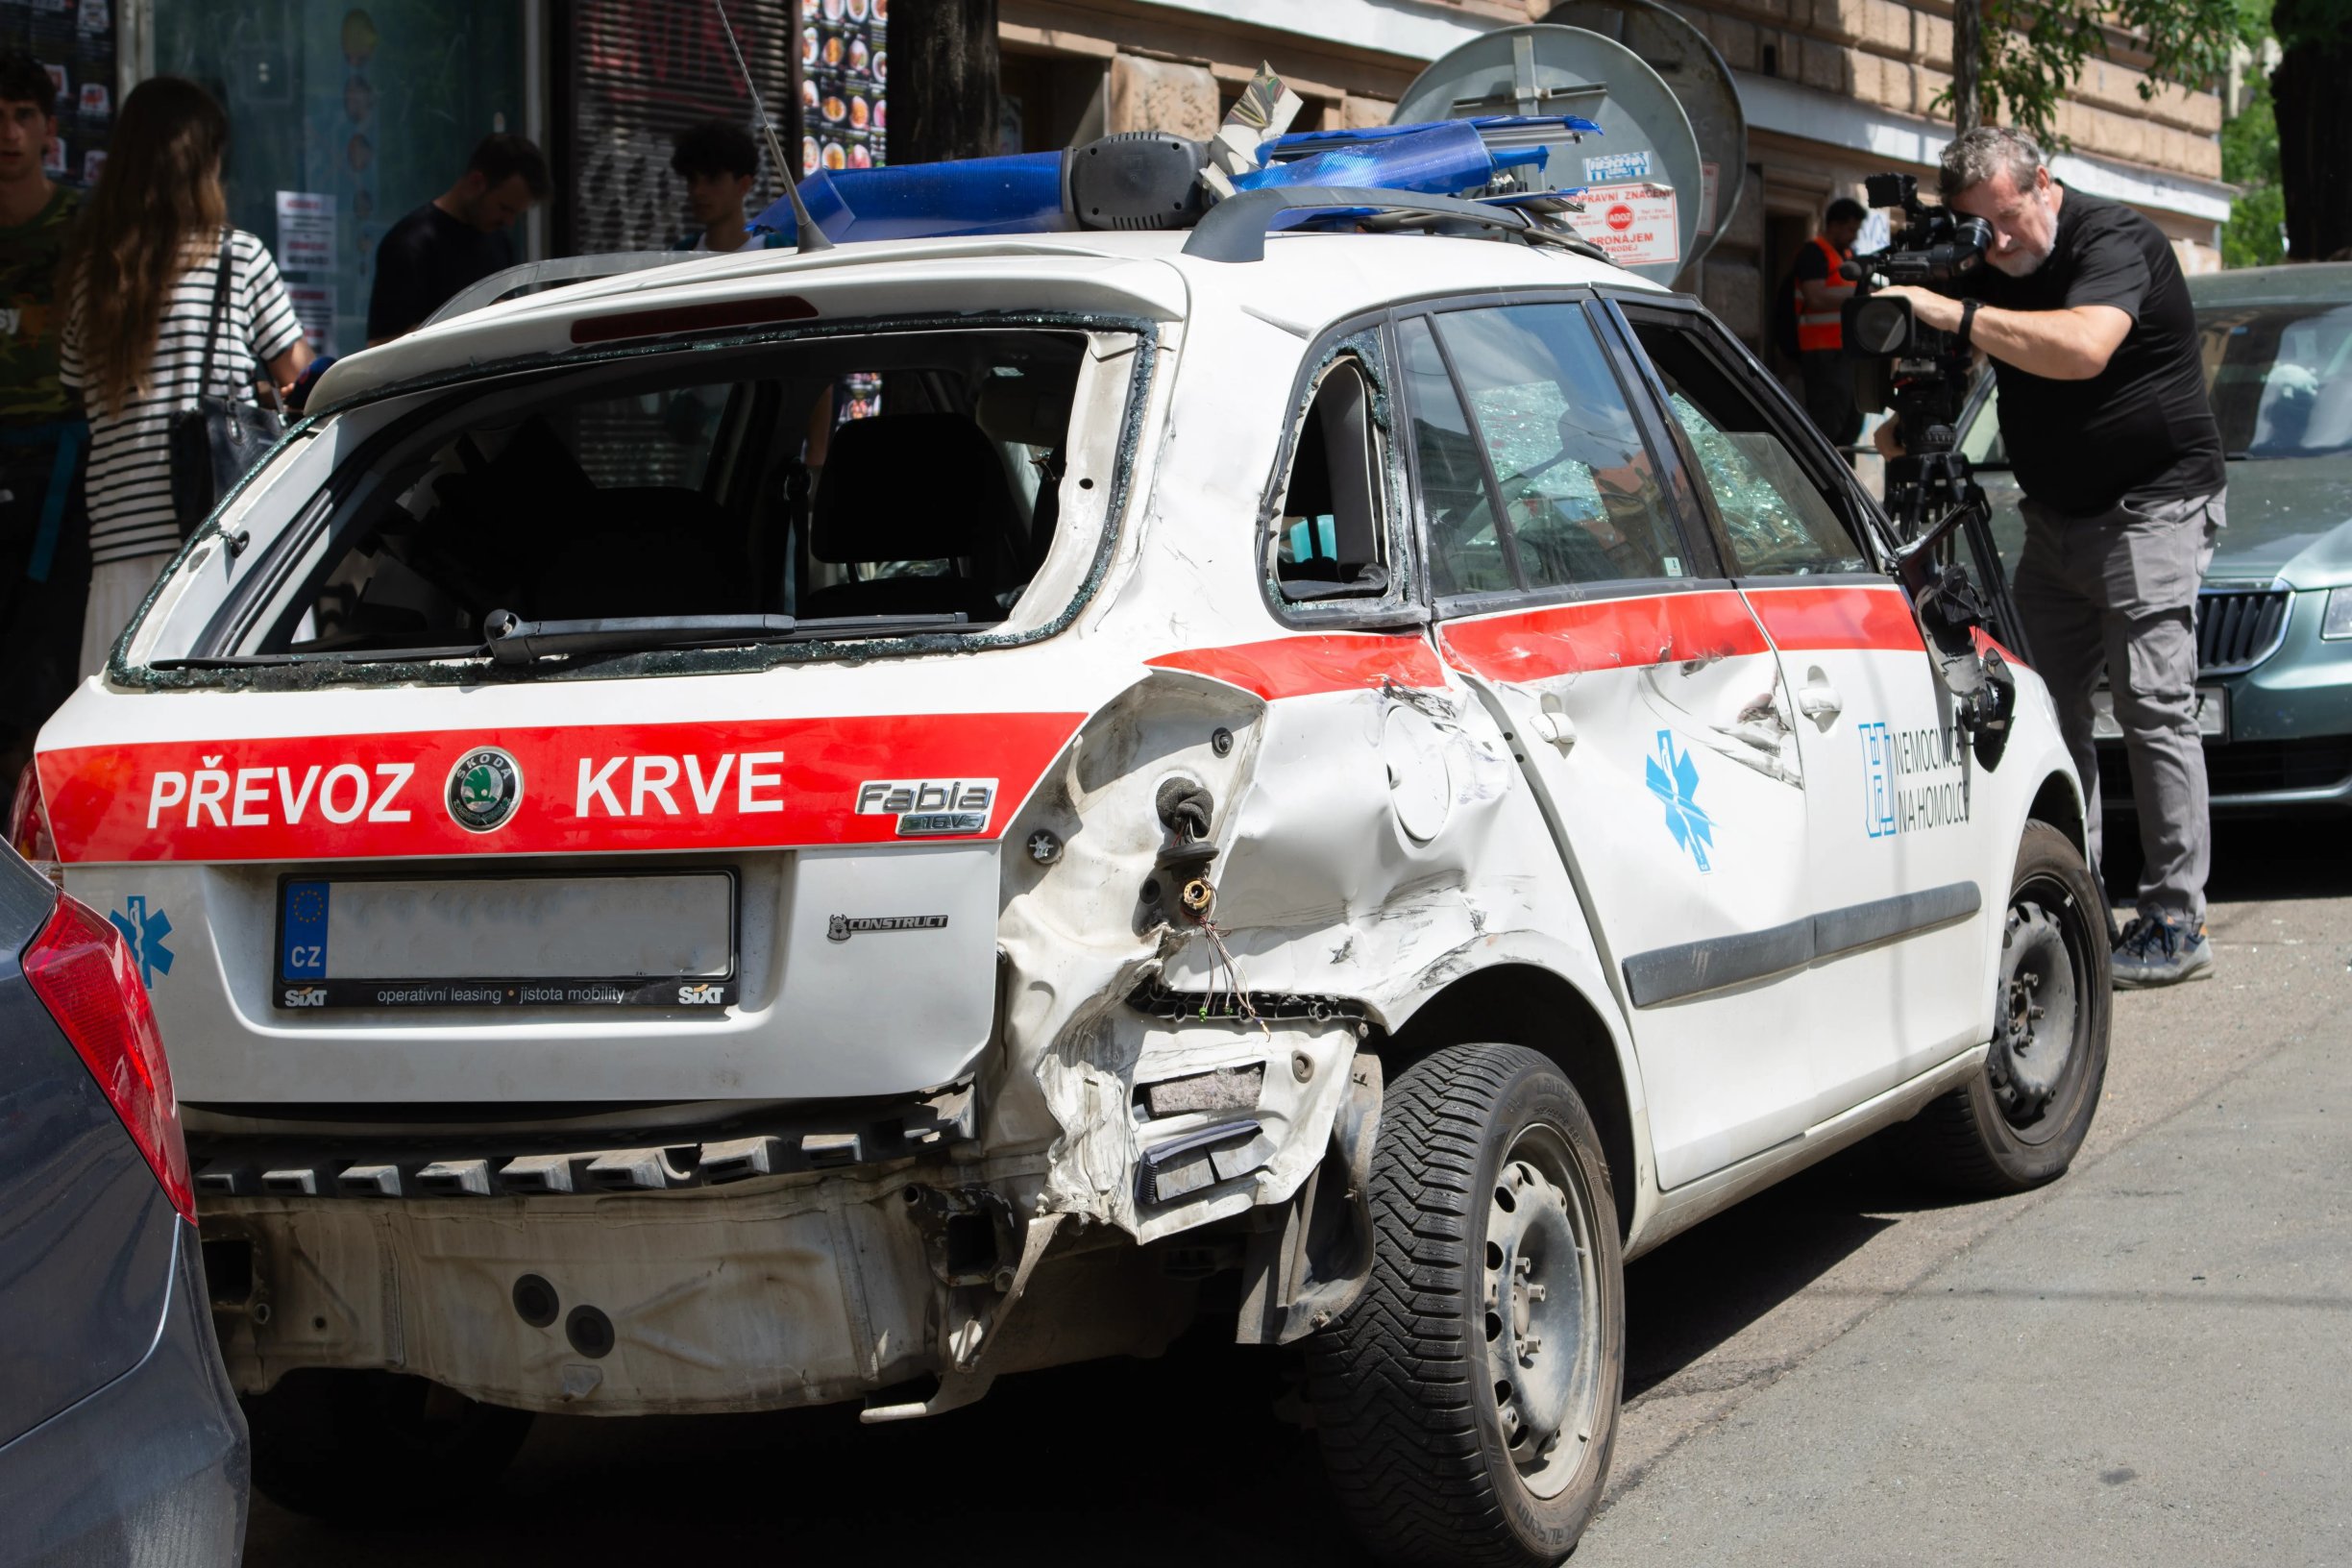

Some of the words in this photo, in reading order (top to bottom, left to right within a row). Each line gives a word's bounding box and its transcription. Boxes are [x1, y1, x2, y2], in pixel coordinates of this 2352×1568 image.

[1608, 213, 1631, 223] ADOZ
[1605, 244, 1638, 253] PRODEJ
[146, 755, 415, 829] PŘEVOZ
[576, 751, 784, 818] KRVE
[856, 780, 993, 815] Fabia
[1898, 789, 1917, 834] NA
[1918, 780, 1970, 831] HOMOLCE
[848, 915, 948, 932] CONSTRUCT
[291, 945, 322, 968] CZ
[377, 987, 447, 1005] operativní
[451, 987, 502, 1005] leasing
[519, 986, 564, 1004] jistota
[568, 986, 625, 1004] mobility
